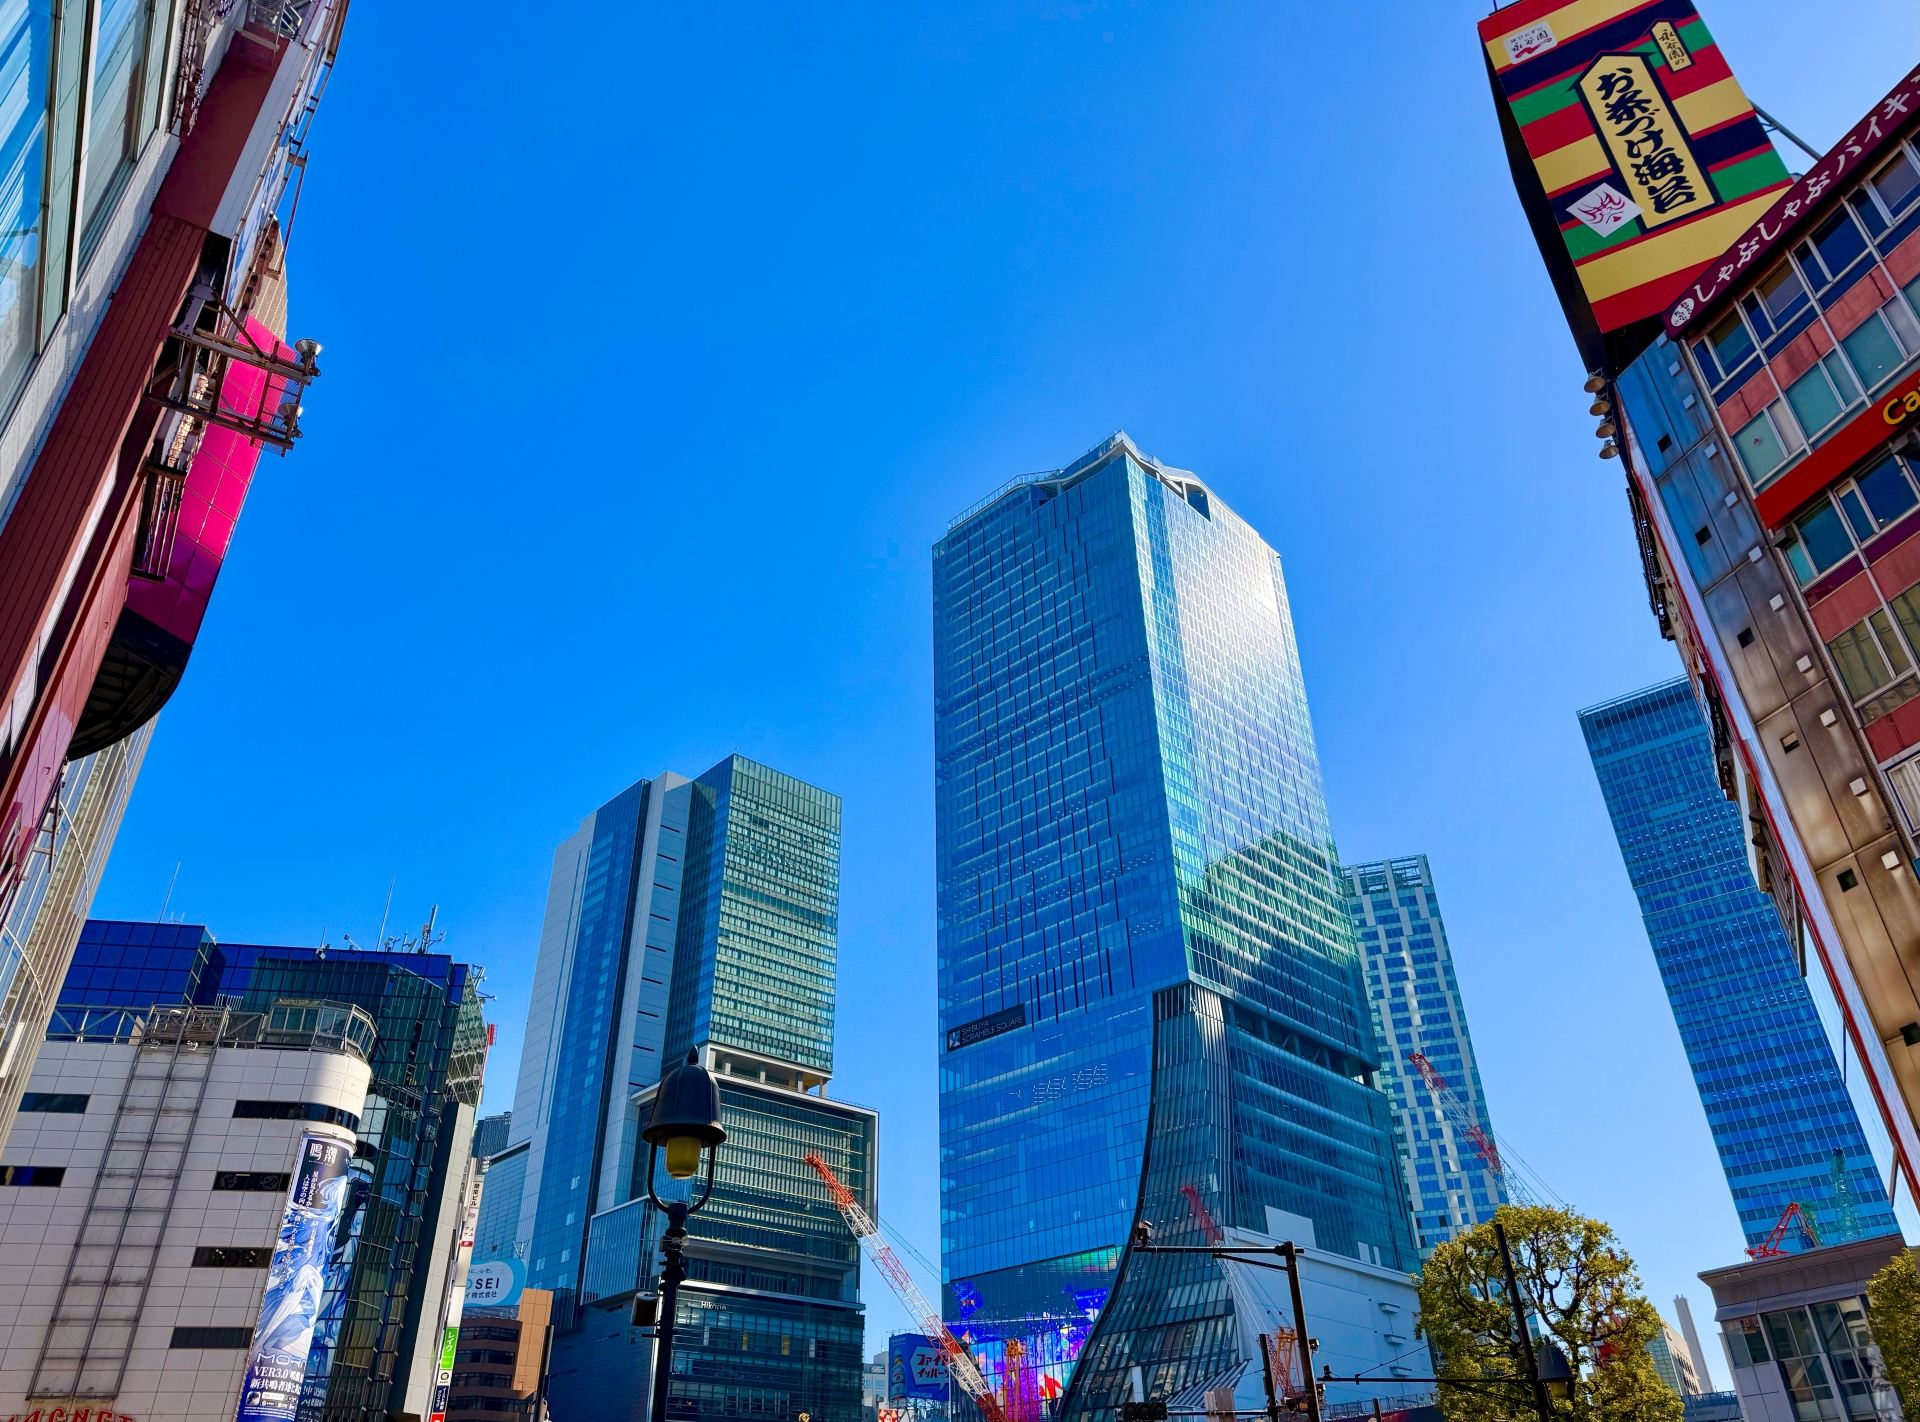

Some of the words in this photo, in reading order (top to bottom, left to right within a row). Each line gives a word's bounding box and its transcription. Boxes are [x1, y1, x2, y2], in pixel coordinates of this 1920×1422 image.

[1511, 29, 1548, 53] 永谷園
[1659, 29, 1685, 66] 永谷園の
[1596, 67, 1697, 214] お茶づけ海苔
[1883, 378, 1920, 425] Ca
[961, 1020, 990, 1036] SHIBUYA
[961, 1025, 996, 1044] SCRAMBLE
[996, 1015, 1024, 1032] SQUARE
[309, 1143, 338, 1165] 鳴潮
[446, 1331, 455, 1352] レイク
